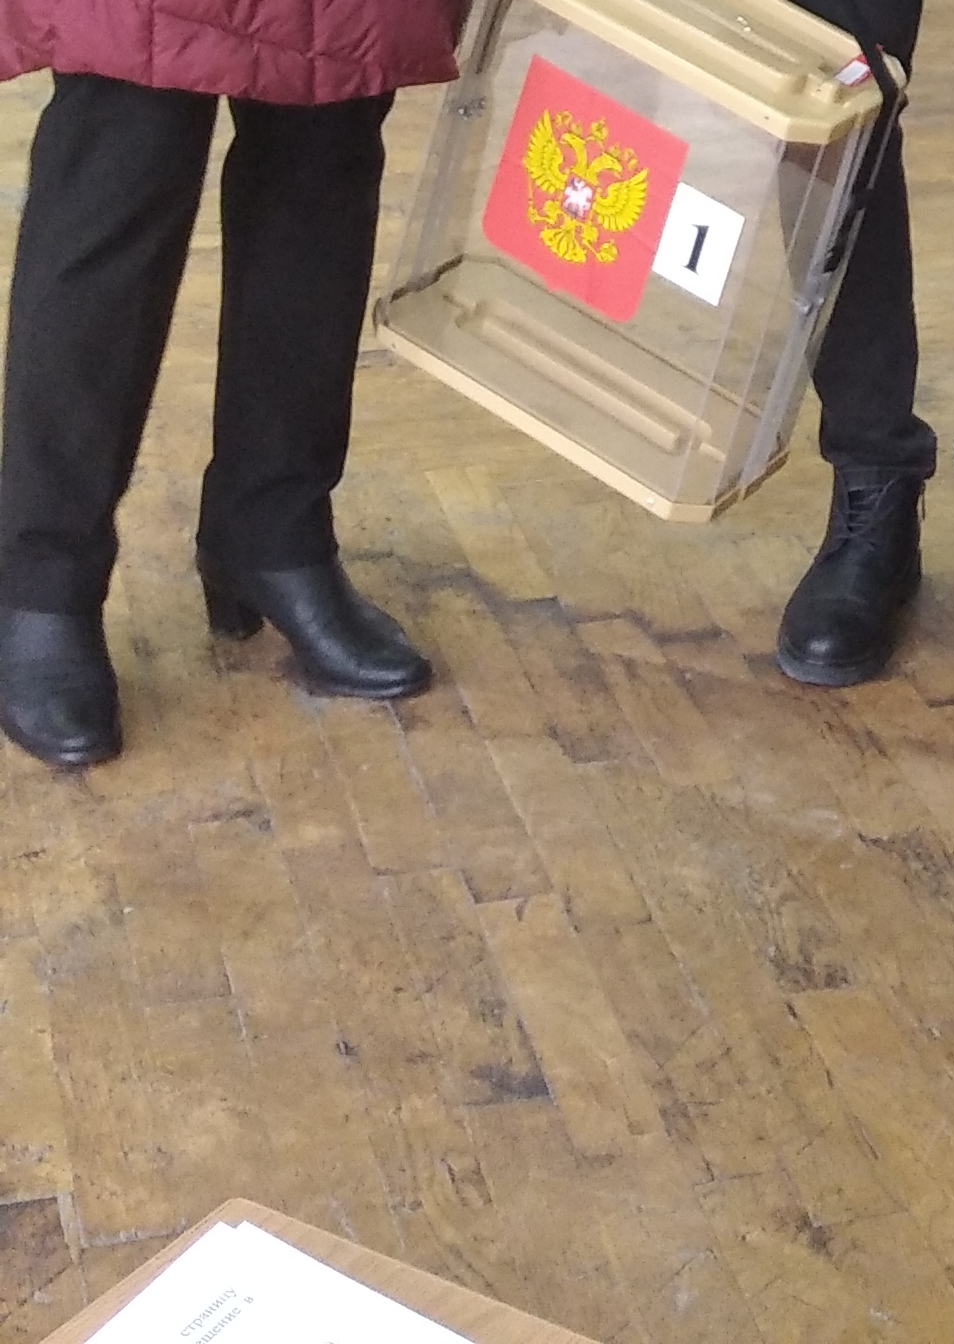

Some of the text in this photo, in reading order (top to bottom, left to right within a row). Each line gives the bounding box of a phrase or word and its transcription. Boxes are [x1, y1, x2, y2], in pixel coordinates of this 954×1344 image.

[681, 223, 710, 276] 1
[180, 1287, 237, 1338] страницу
[243, 1295, 254, 1305] в
